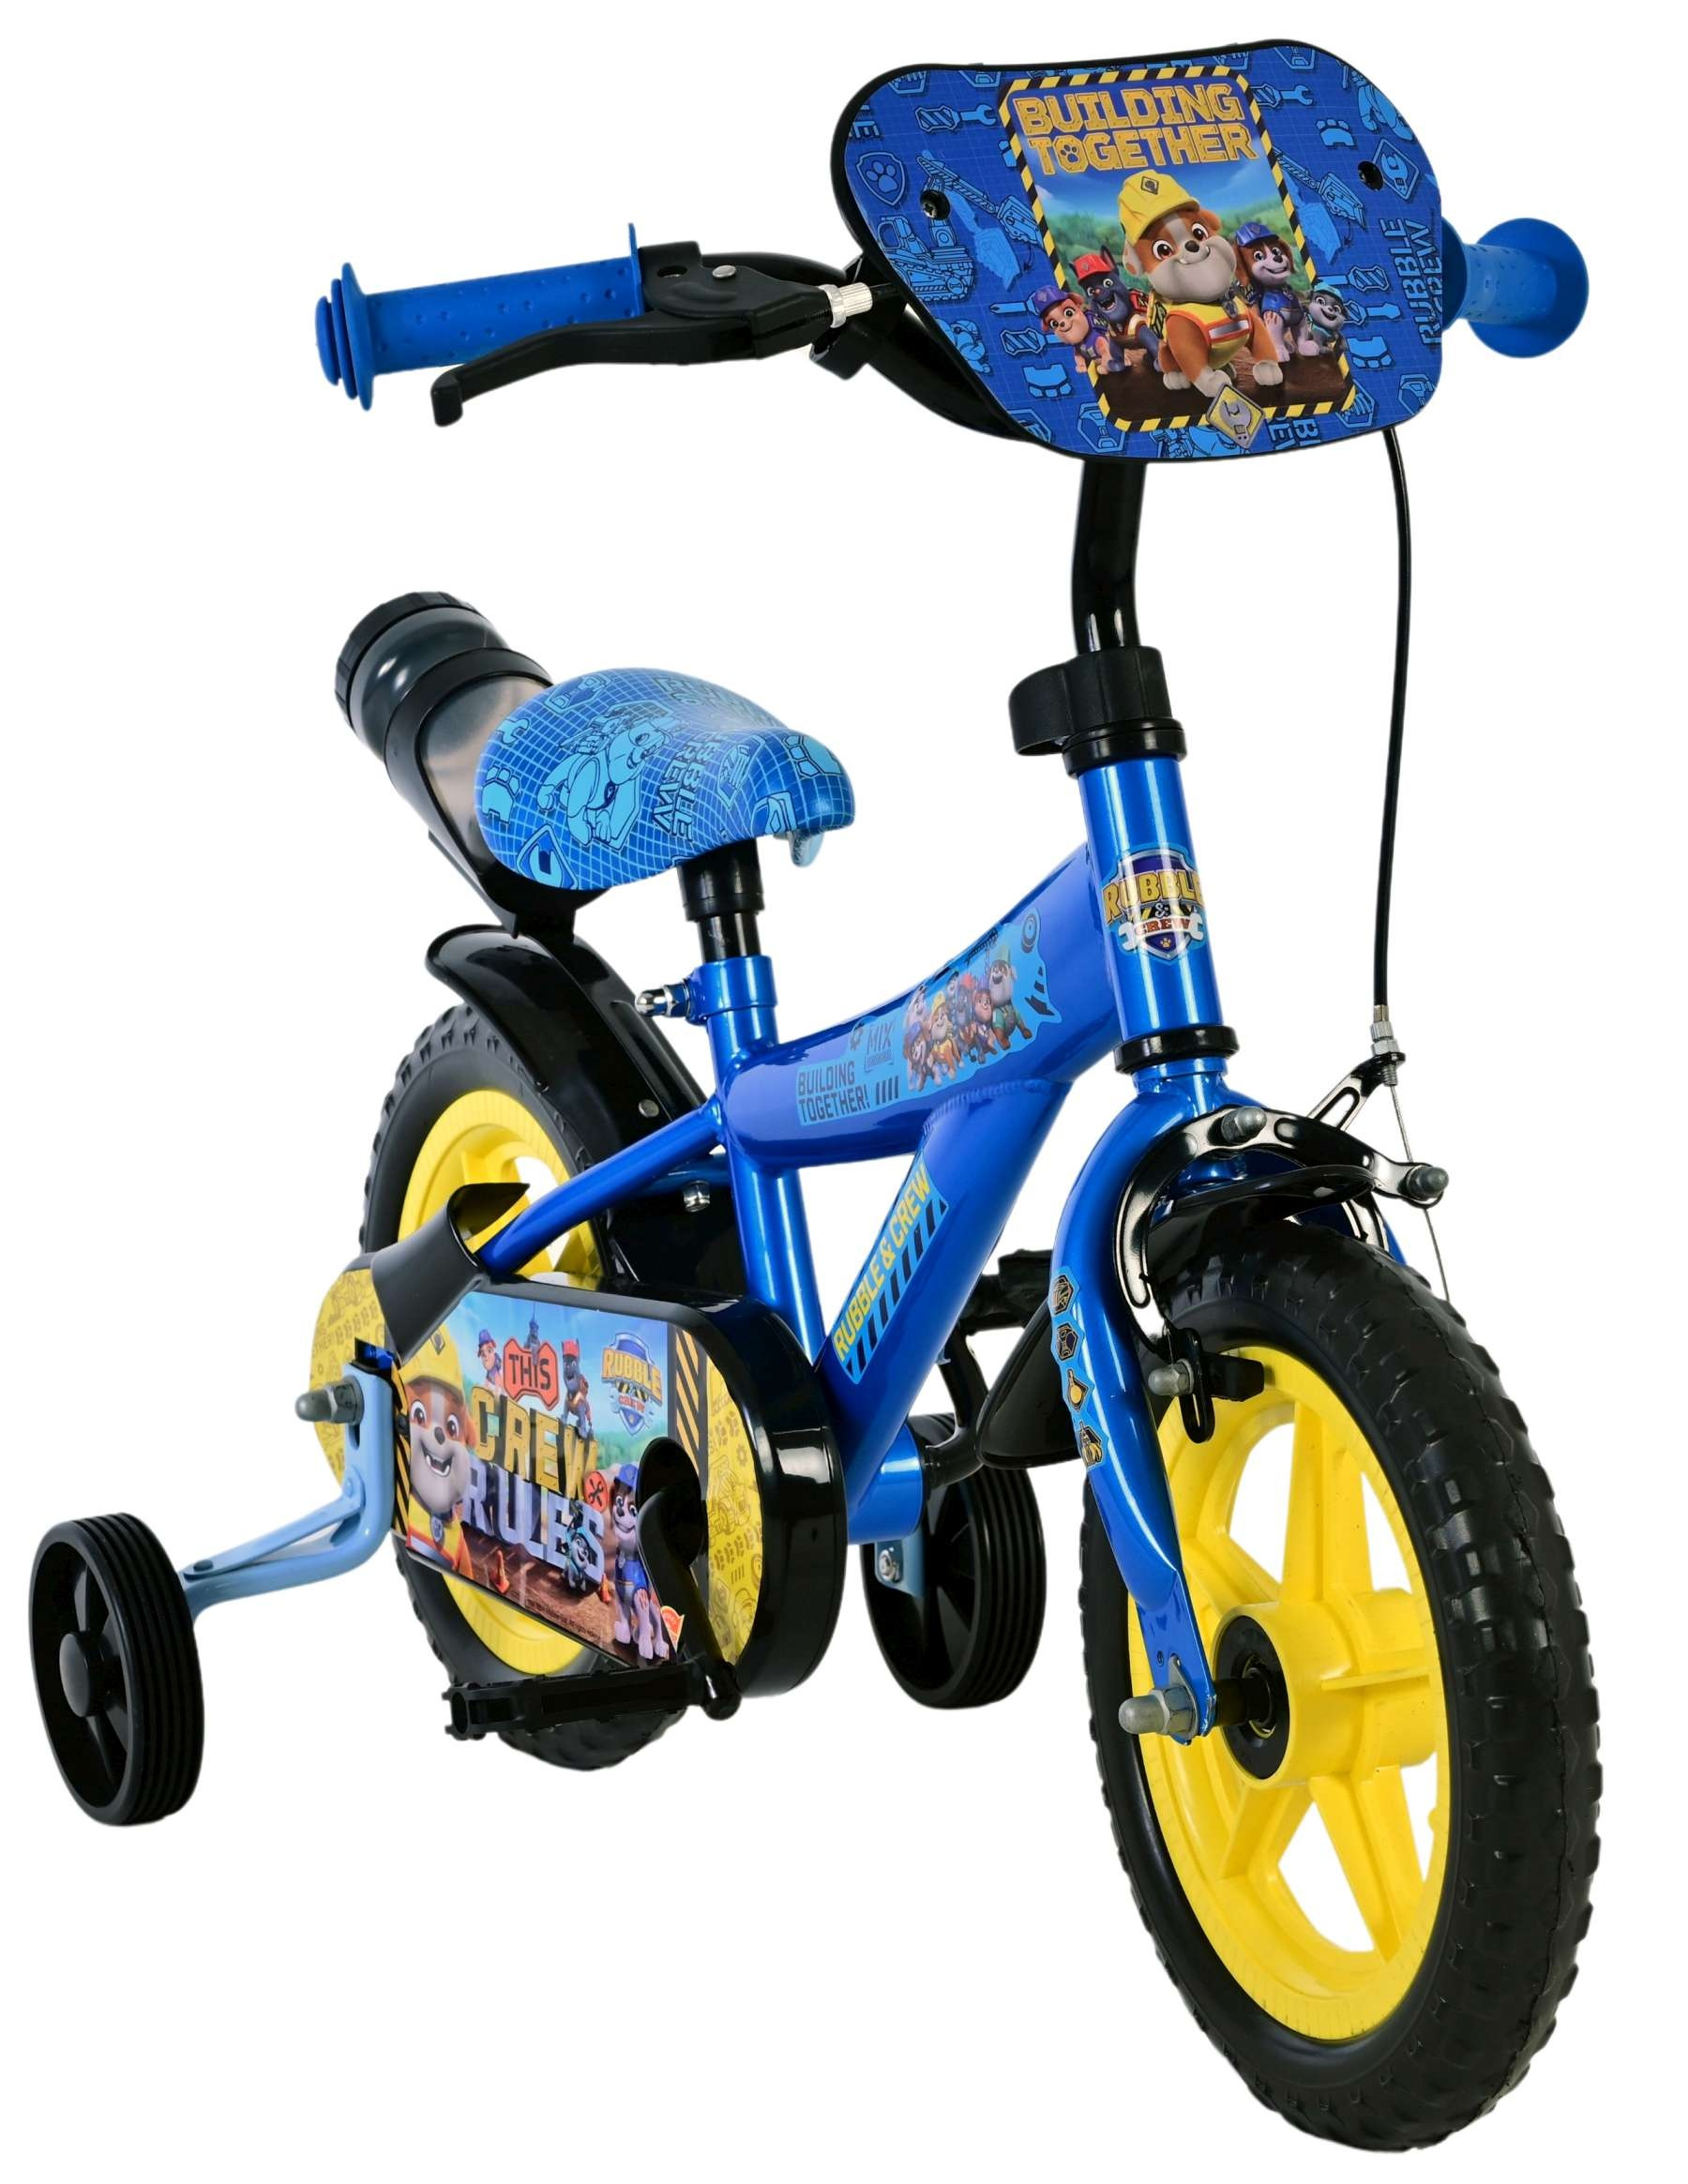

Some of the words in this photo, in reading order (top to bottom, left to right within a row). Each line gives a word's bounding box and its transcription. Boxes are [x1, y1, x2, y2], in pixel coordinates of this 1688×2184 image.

[1014, 83, 1245, 136] BUILDING
[1028, 123, 1259, 175] TOGETHER
[1405, 218, 1442, 314] REW
[653, 734, 704, 834] REW
[798, 1061, 855, 1096] BUILDING
[798, 1084, 871, 1122] TOGETHER!
[832, 1257, 886, 1362] RUBBLE
[879, 1235, 897, 1271] &
[888, 1162, 932, 1249] CREW
[508, 1353, 552, 1391] THIS
[601, 1347, 663, 1407] RUBBLE
[471, 1385, 599, 1502] CREW
